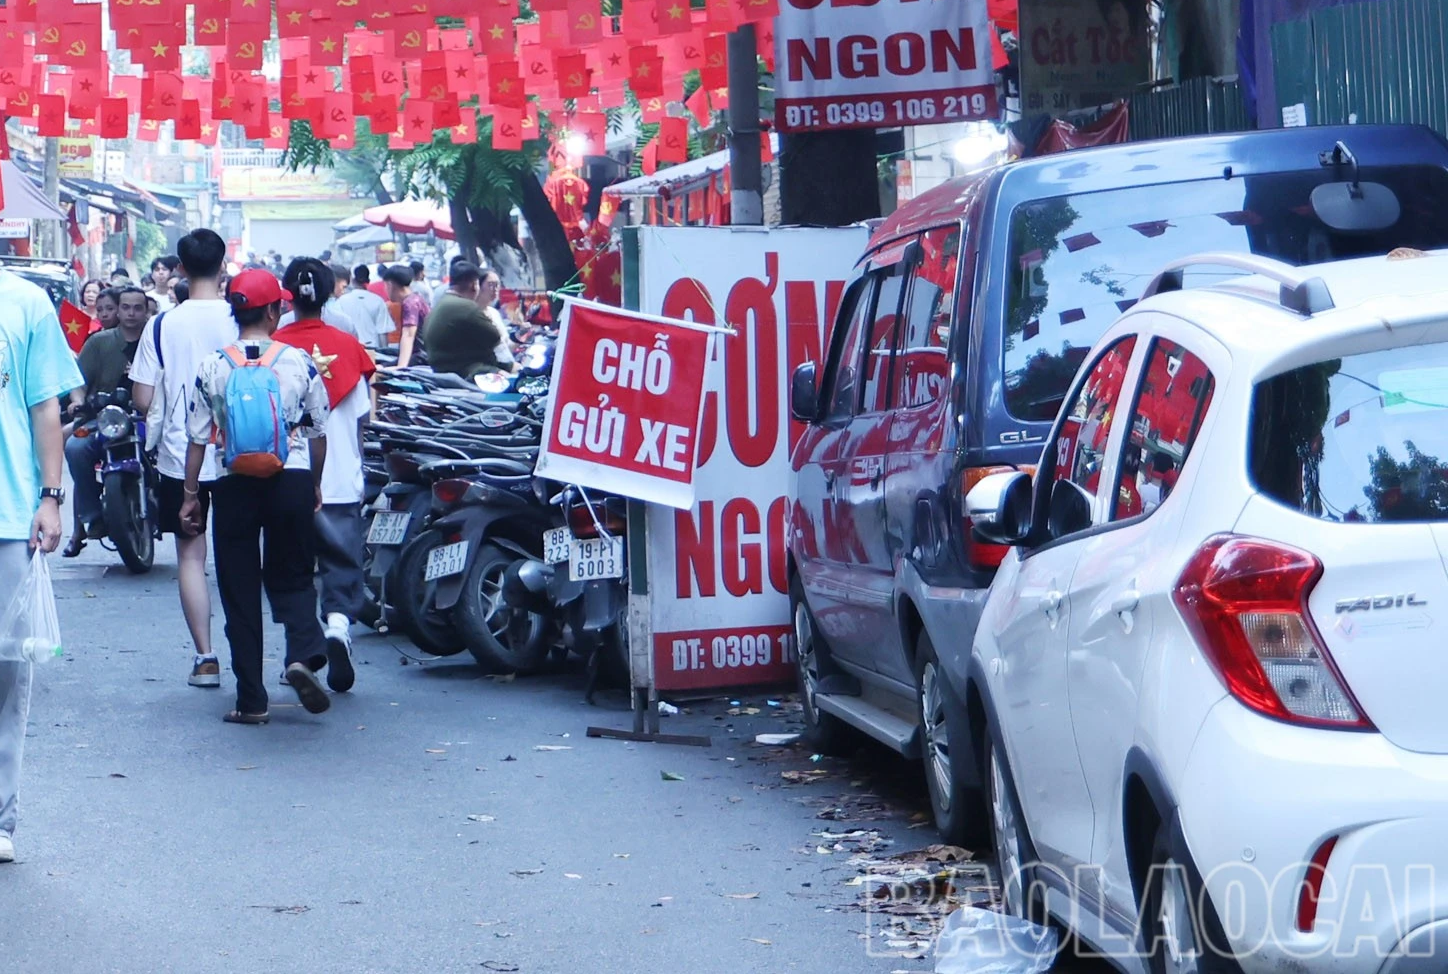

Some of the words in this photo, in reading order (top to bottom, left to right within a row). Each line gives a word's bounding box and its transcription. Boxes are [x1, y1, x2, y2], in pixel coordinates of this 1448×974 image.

[787, 27, 977, 82] NGON
[785, 105, 819, 126] ĐT:
[826, 101, 885, 125] 0399
[892, 97, 936, 121] 106
[943, 93, 986, 118] 219
[591, 332, 672, 396] CHỖ
[557, 393, 626, 458] GỬI
[633, 416, 691, 474] XE
[577, 560, 616, 577] 6003
[1335, 591, 1428, 615] FADIL
[672, 638, 705, 672] ĐT:
[712, 634, 771, 669] 0399
